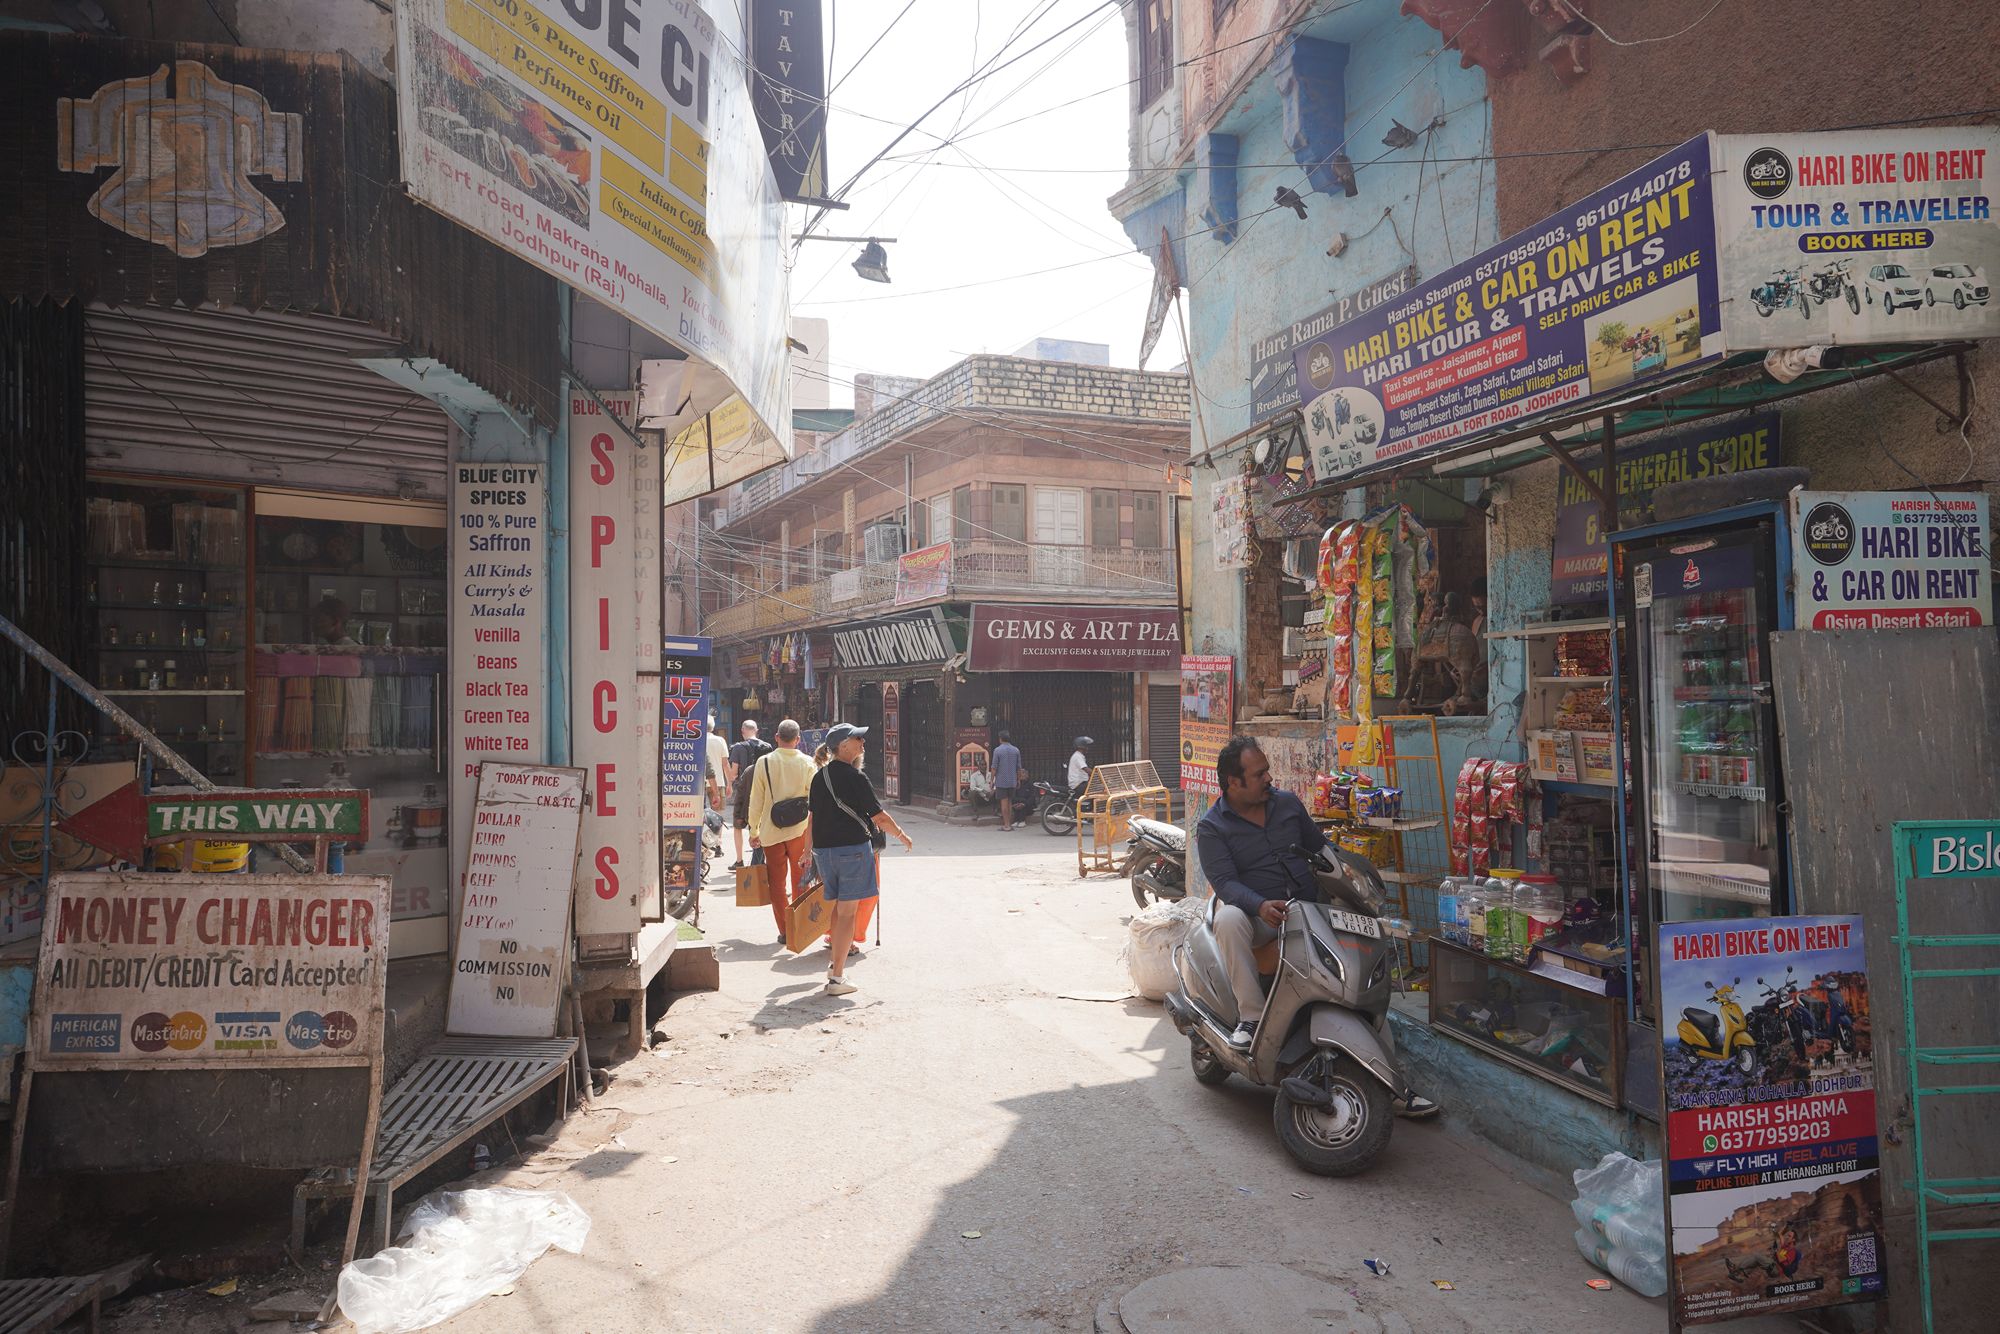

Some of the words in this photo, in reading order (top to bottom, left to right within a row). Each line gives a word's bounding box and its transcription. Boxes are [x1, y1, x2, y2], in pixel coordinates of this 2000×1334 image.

[545, 25, 585, 66] Pure
[588, 60, 645, 111] Saffron
[513, 44, 592, 112] Perfumes
[596, 101, 620, 131] Oil
[777, 9, 795, 156] TAVERN
[1798, 155, 1845, 187] HARI
[1852, 153, 1896, 185] BIKE
[1903, 152, 1929, 183] ON
[1935, 149, 1986, 181] RENT
[640, 180, 677, 216] Indian
[612, 197, 650, 232] (Special
[1751, 203, 1821, 229] TOUR
[1831, 202, 1849, 226] &
[1859, 196, 1990, 225] TRAVELER
[477, 182, 530, 227] road,
[537, 213, 609, 267] Makrana
[614, 260, 670, 310] Mohalla,
[1387, 300, 1424, 325] Harish
[1426, 275, 1473, 304] Sharma
[1475, 226, 1571, 282] 6377959203,
[1576, 160, 1692, 232] 9610744078
[1807, 233, 1865, 251] BOOK
[1873, 231, 1927, 248] HERE
[501, 220, 579, 283] Jodhpur
[584, 266, 626, 304] (Raj.)
[1343, 333, 1391, 373] HARI
[1395, 303, 1448, 350] BIKE
[1455, 291, 1474, 323] &
[1482, 260, 1538, 311] CAR
[1546, 234, 1591, 282] ON
[1600, 178, 1696, 257] RENT
[1540, 308, 1567, 331] SELF
[1572, 292, 1611, 316] DRIVE
[1614, 280, 1642, 300] CAR
[1663, 250, 1701, 279] BIKE
[1254, 334, 1288, 362] Hare
[1291, 312, 1334, 345] Rama
[1357, 269, 1407, 312] Guest
[1363, 354, 1412, 387] HARI
[1417, 321, 1482, 357] TOUR
[1490, 309, 1511, 332] &
[1519, 237, 1666, 319] TRAVELS
[1402, 369, 1433, 389] Service
[1492, 331, 1522, 351] Ajmer
[1537, 350, 1563, 370] Safari
[1375, 438, 1413, 460] MAKRANA
[1463, 415, 1489, 435] FORT
[1525, 384, 1580, 413] JODHPUR
[459, 469, 497, 484] BLUE
[502, 468, 537, 484] CITY
[1615, 448, 1692, 495] ENERAL
[470, 490, 527, 505] SPICES
[1891, 501, 1930, 511] HARISH
[1933, 500, 1977, 511] SHARMA
[460, 515, 484, 528] 100
[504, 514, 537, 529] Pure
[1903, 513, 1977, 524] 6377959203
[469, 534, 530, 551] Saffron
[1862, 527, 1919, 559] HARI
[1927, 526, 1982, 558] BIKE
[464, 564, 487, 577] All
[489, 564, 532, 577] Kinds
[464, 583, 515, 600] Curry's
[1812, 570, 1829, 602] &
[1842, 570, 1885, 601] CAR
[1892, 569, 1920, 600] ON
[1926, 569, 1980, 599] RENT
[470, 603, 525, 617] Masala
[1872, 613, 1921, 629] Desert
[1925, 611, 1970, 628] Safari
[474, 628, 520, 642] Venilla
[988, 619, 1054, 640] GEMS
[1060, 621, 1076, 639] &
[1083, 621, 1132, 641] ART
[834, 628, 868, 668] SILVER
[867, 618, 945, 665] EMPORIUM
[1023, 647, 1067, 656] EXCLUSIVE
[1069, 648, 1091, 656] GEMS
[1092, 648, 1099, 656] &
[1100, 648, 1126, 656] SILVER
[1127, 648, 1171, 657] JEWELLERY
[477, 655, 518, 670] Beans
[590, 433, 620, 900] SPICES
[466, 683, 502, 697] Black
[505, 683, 528, 697] Tea
[464, 709, 503, 724] Green
[506, 710, 530, 724] Tea
[465, 736, 503, 751] White
[506, 736, 529, 751] Tea
[685, 764, 699, 772] OIL
[1181, 764, 1203, 780] HARI
[496, 772, 531, 785] TODAY
[532, 776, 560, 787] PRICE
[156, 805, 239, 831] THIS
[252, 803, 343, 829] WAY
[478, 812, 521, 827] DOLLAR
[674, 811, 695, 819] Safari
[475, 832, 505, 846] EURO
[472, 854, 517, 868] POUNDS
[56, 897, 188, 945] MONEY
[196, 898, 374, 947] CHANGER
[499, 940, 517, 955] NO
[1673, 934, 1720, 961] HARI
[1725, 930, 1768, 957] BIKE
[1773, 928, 1800, 953] ON
[1805, 924, 1851, 951] RENT
[86, 953, 224, 993] DEBIT/CREDIT
[229, 958, 278, 987] Card
[281, 958, 369, 996] Accepted
[458, 959, 551, 978] COMMISSION
[496, 986, 514, 1000] NO
[53, 1018, 118, 1033] AMERICAN
[134, 1024, 203, 1043] MasterCard
[219, 1024, 273, 1039] VISA
[65, 1035, 116, 1049] EXPRESS
[1680, 1090, 1745, 1108] MAKRANA
[1747, 1081, 1806, 1102] MOHALLA
[1810, 1075, 1862, 1096] JODHPUR
[1698, 1107, 1770, 1132] HARISH
[1774, 1098, 1848, 1124] SHARMA
[1720, 1121, 1831, 1150] 6377959203
[1717, 1157, 1745, 1172] FLY
[1748, 1153, 1778, 1168] HIGH
[1783, 1149, 1818, 1164] FEEL
[1820, 1143, 1857, 1159] ALIVE
[1695, 1177, 1733, 1192] ZIPLINE
[1735, 1174, 1760, 1187] TOUR
[1761, 1172, 1772, 1184] AT
[1774, 1164, 1834, 1183] MEHRANGARH
[1835, 1159, 1857, 1173] FORT
[1774, 1286, 1795, 1294] BOOK
[1796, 1281, 1816, 1291] HERE
